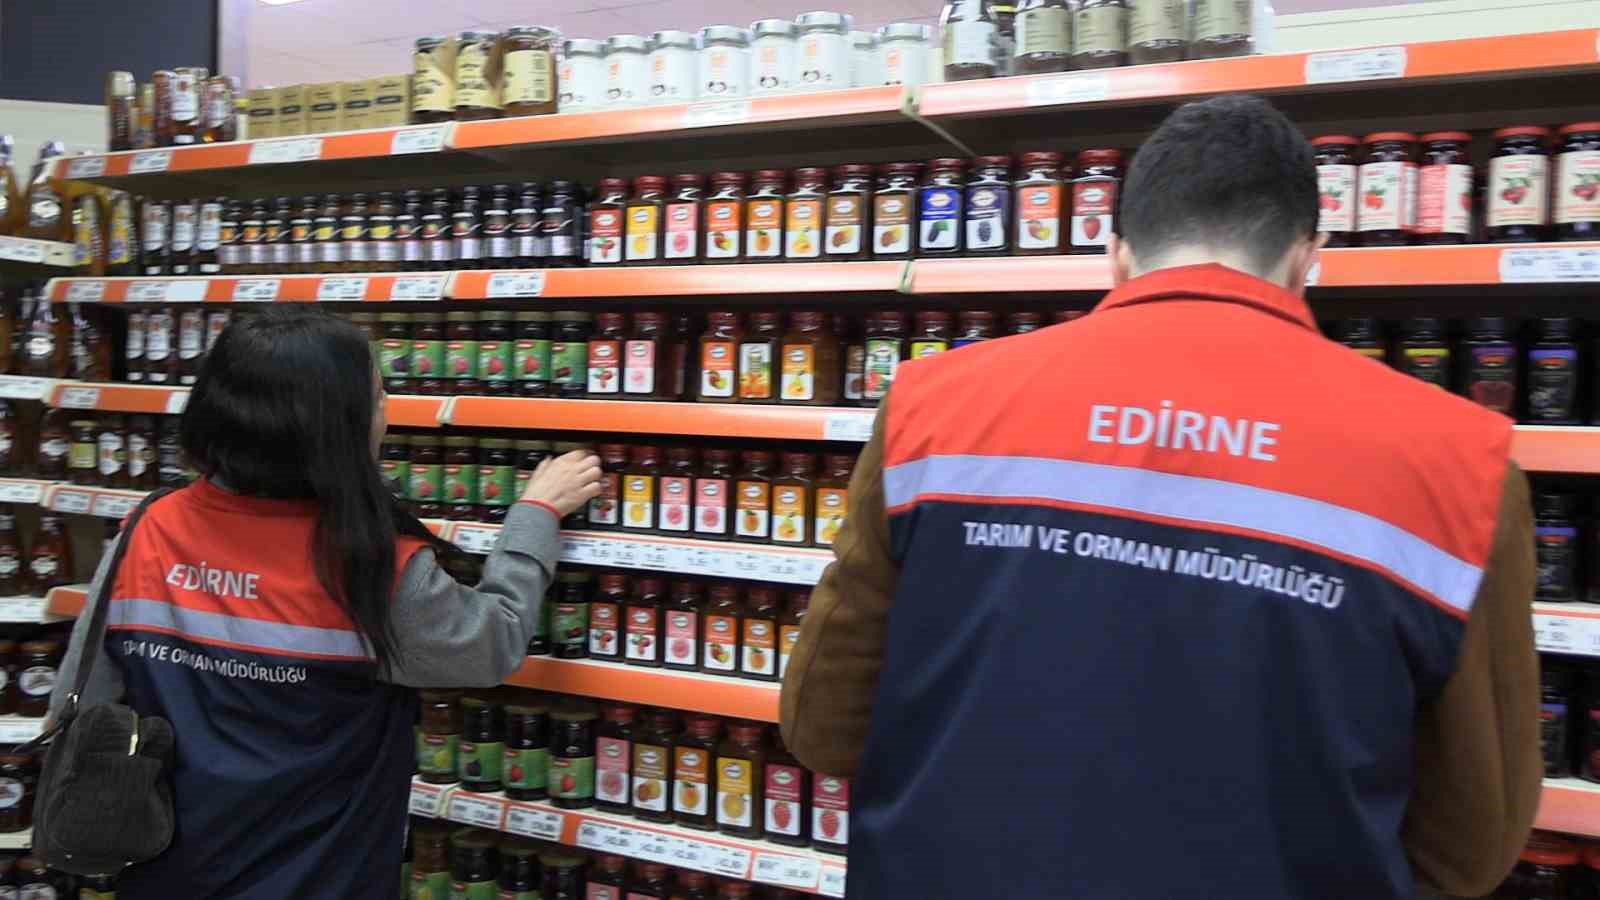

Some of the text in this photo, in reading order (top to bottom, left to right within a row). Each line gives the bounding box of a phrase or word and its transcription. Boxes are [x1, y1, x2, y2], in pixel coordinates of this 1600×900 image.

[1087, 399, 1281, 462] EDİRNE
[165, 560, 261, 600] EDİRNE
[962, 520, 1345, 610] TARIM VE ORMAN MÜDÜRLÜĞÜ
[149, 642, 170, 661] VE
